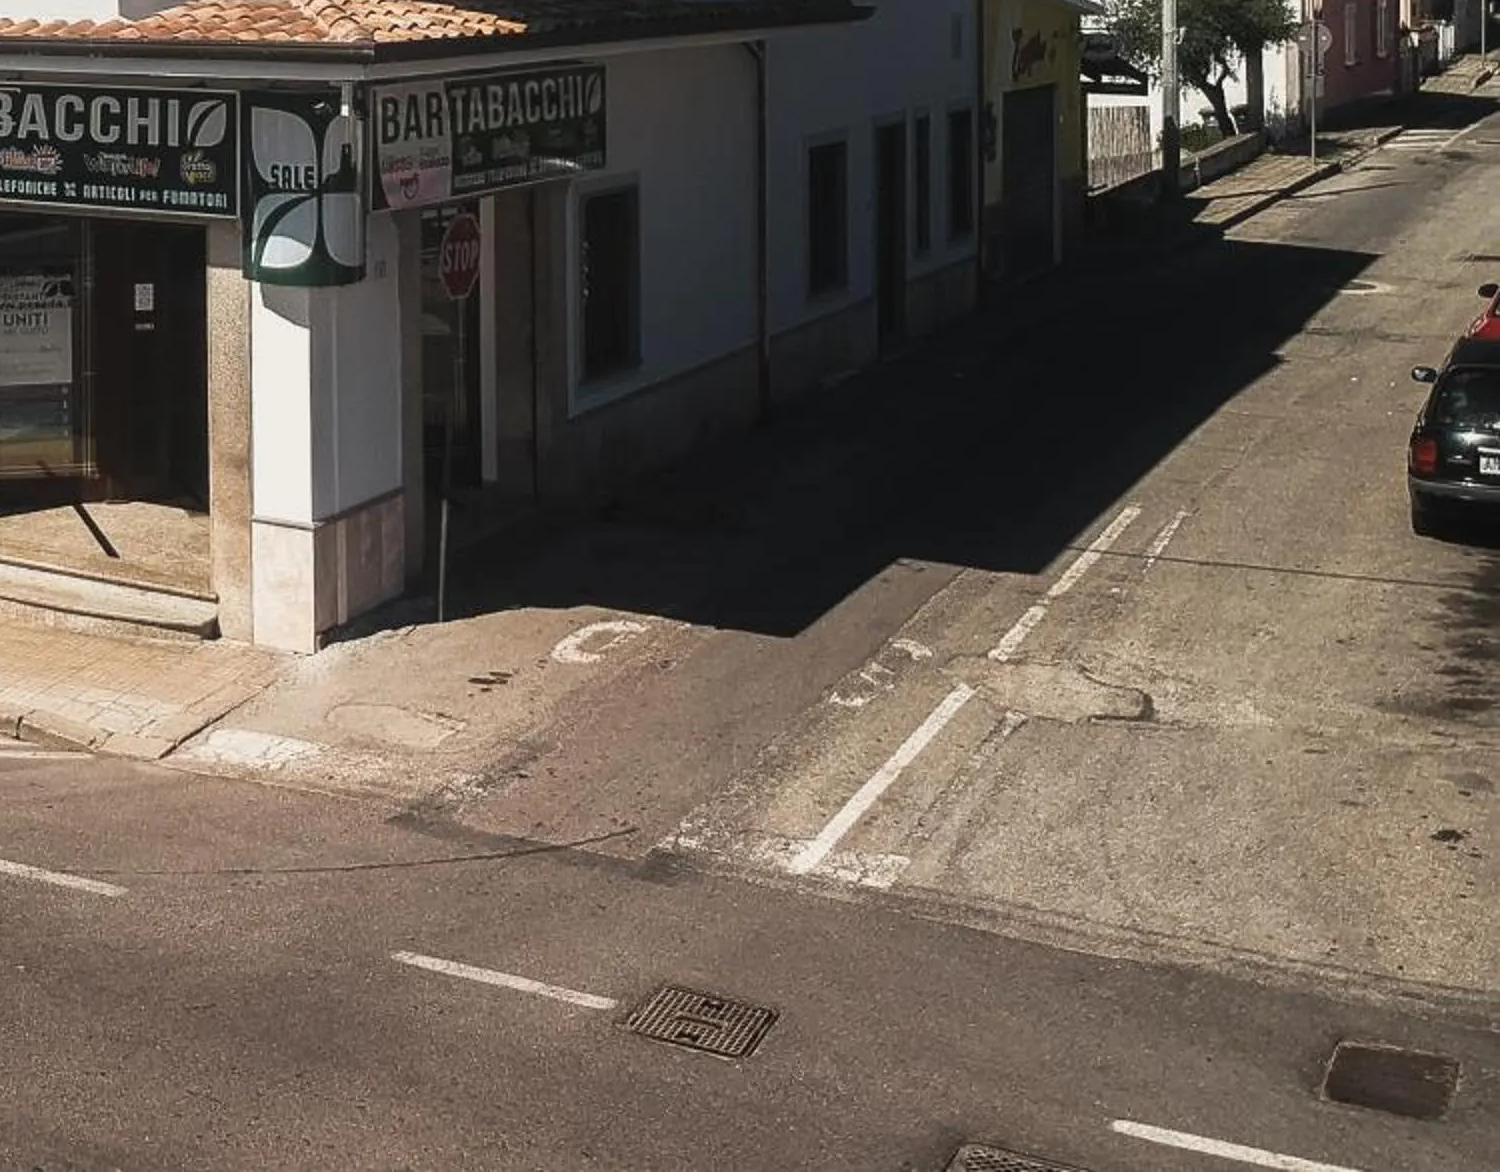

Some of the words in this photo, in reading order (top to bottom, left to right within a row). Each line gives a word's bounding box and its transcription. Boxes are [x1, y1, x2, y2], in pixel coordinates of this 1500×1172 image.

[381, 91, 443, 145] BAR
[450, 74, 583, 134] TABACCHI
[269, 164, 316, 190] SALE
[82, 183, 136, 202] ARTICOLI
[162, 188, 229, 209] FUMATORI
[443, 239, 479, 274] STOP
